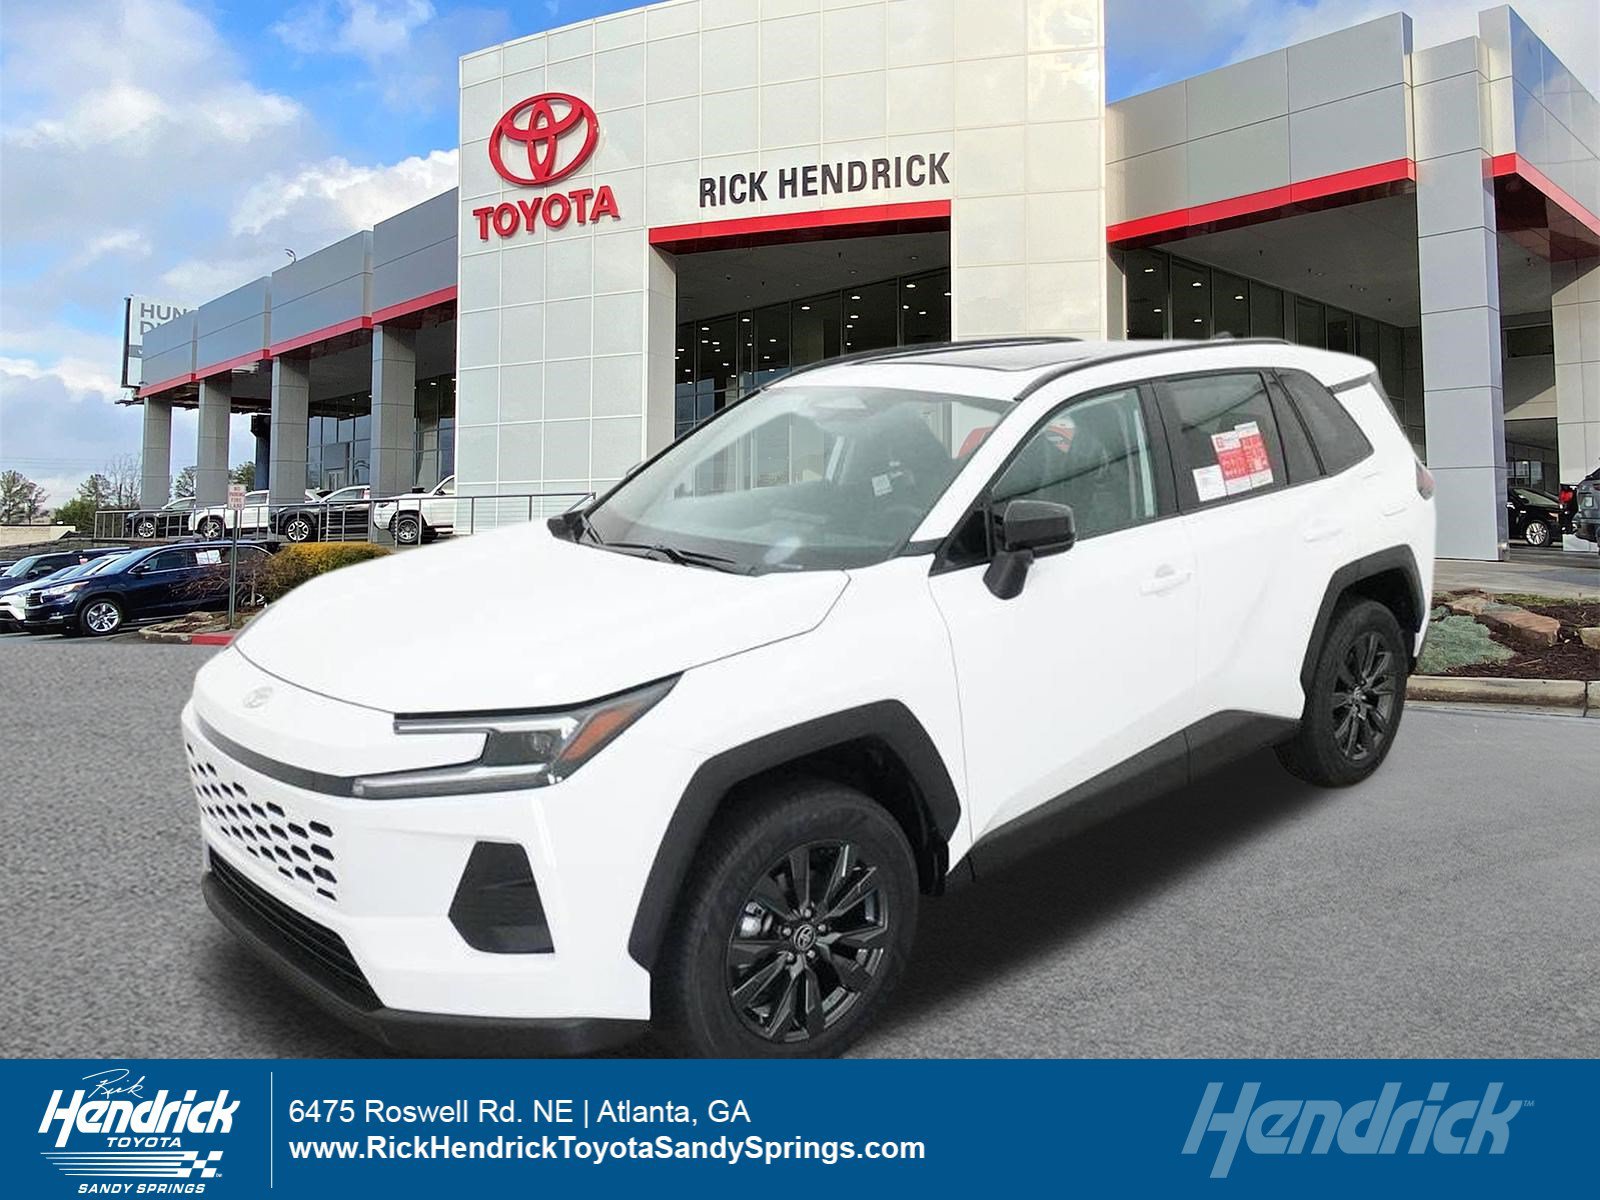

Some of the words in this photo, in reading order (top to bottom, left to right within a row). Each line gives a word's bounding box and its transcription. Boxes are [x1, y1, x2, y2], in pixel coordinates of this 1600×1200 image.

[699, 170, 768, 208] RICK
[779, 151, 951, 200] HENDRICK
[473, 184, 621, 242] TOYOTA
